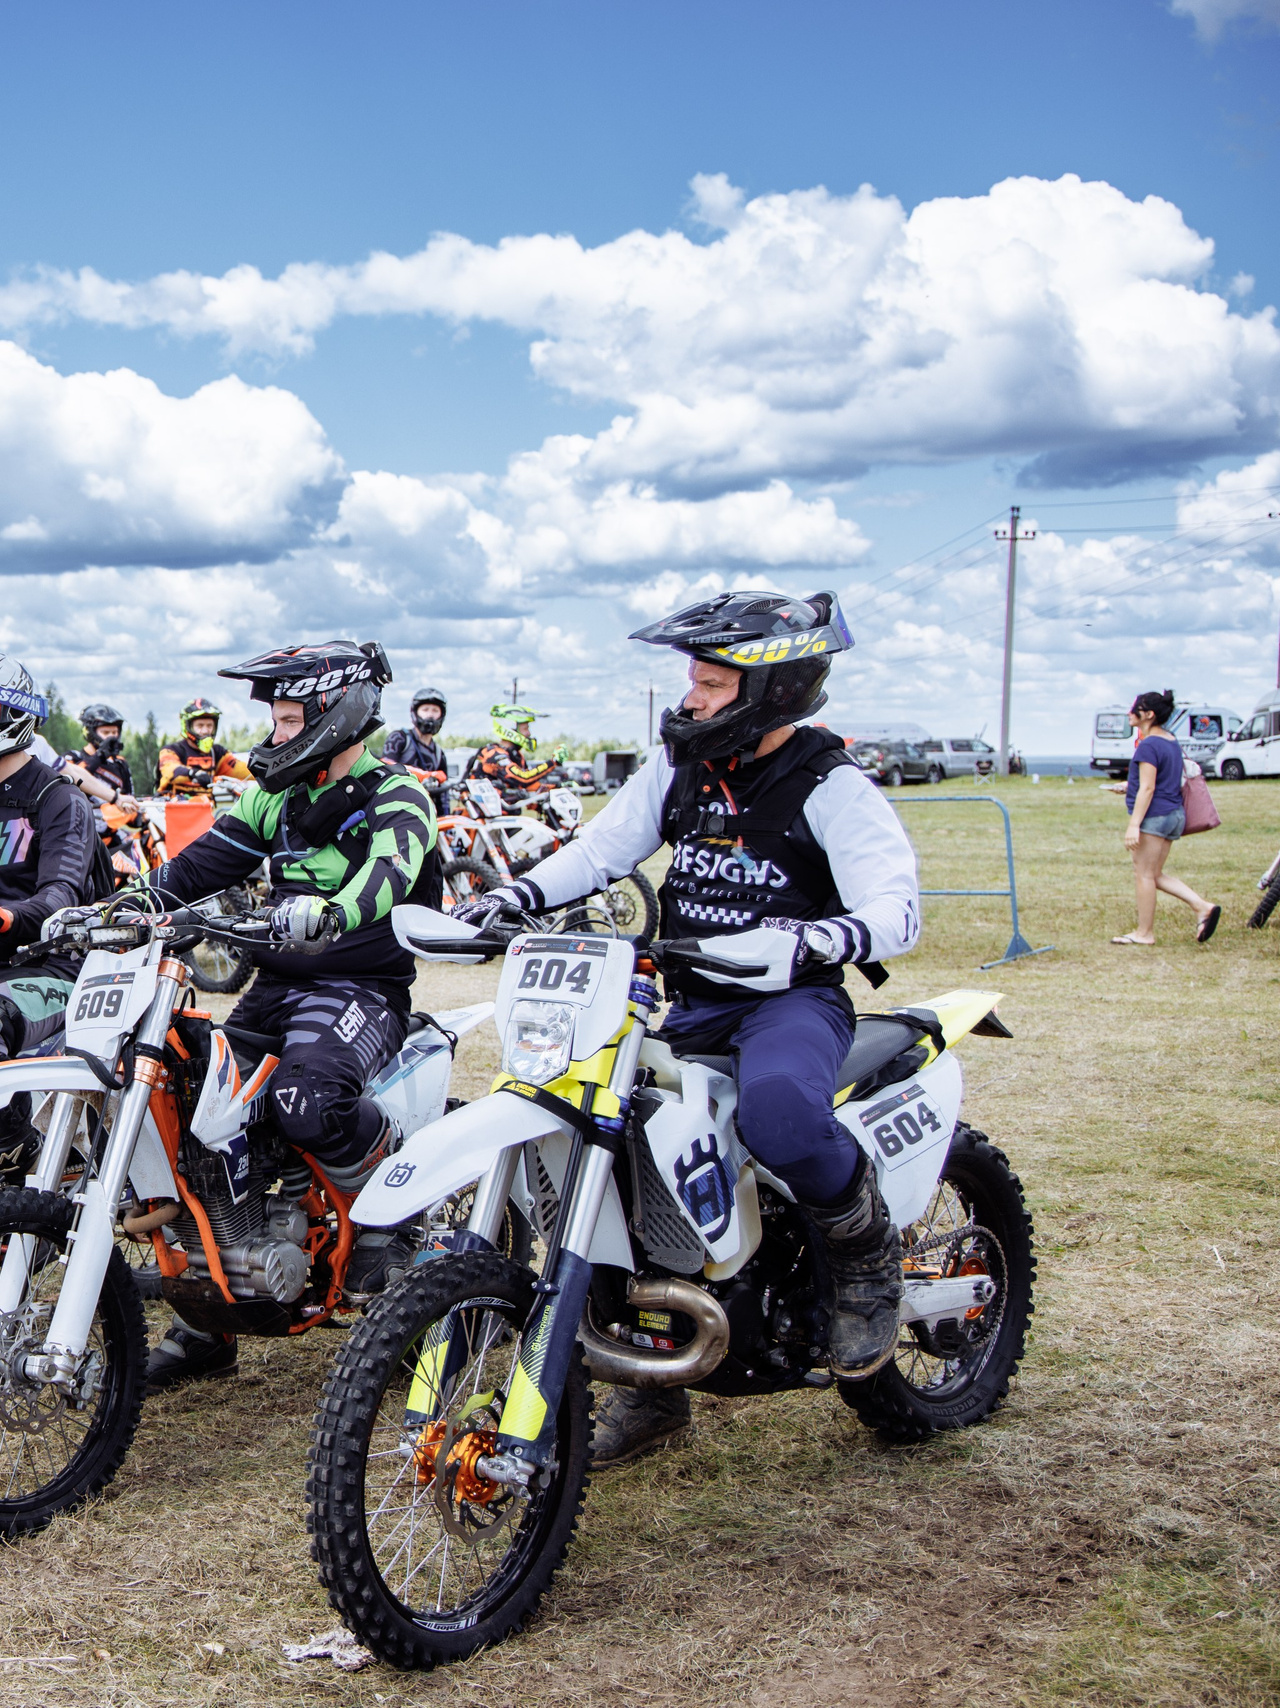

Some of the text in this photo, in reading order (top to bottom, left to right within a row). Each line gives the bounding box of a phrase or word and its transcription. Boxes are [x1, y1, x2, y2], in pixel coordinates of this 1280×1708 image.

[271, 739, 316, 769] ACERBIS
[702, 887, 772, 903] WHEELIES
[518, 958, 592, 994] 604
[74, 989, 124, 1022] 609
[333, 1000, 366, 1043] LEATT
[873, 1101, 942, 1158] 604
[535, 1304, 551, 1343] Husqvarna
[638, 1310, 670, 1324] ENDURO
[638, 1319, 669, 1331] ELEMENT
[932, 1396, 976, 1416] MICHELIN
